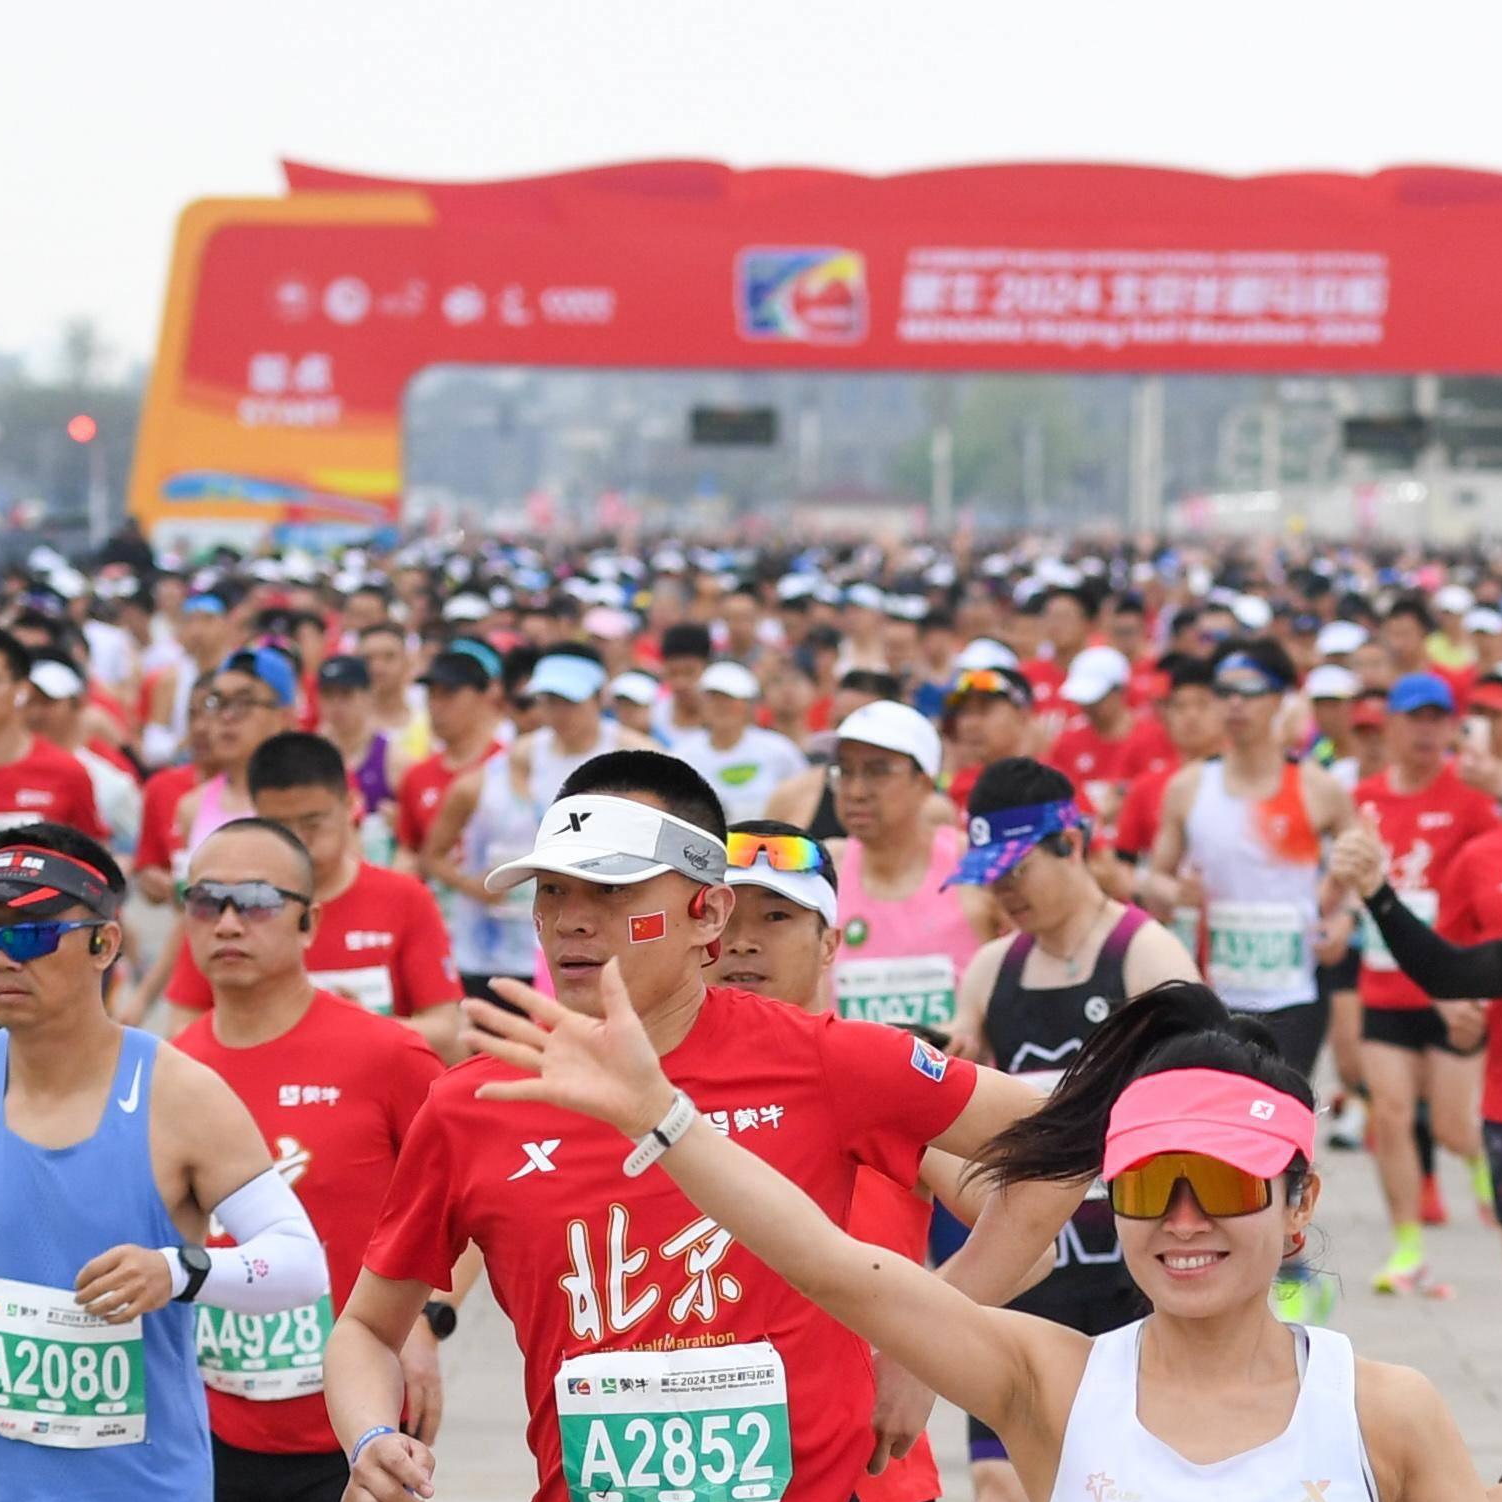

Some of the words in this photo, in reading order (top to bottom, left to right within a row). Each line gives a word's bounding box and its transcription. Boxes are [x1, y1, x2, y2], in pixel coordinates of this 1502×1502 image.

[733, 1104, 785, 1132] 蒙牛
[559, 1203, 742, 1344] 北京
[196, 1304, 323, 1359] A4928
[681, 1376, 706, 1386] 2024
[580, 1411, 774, 1488] A2852
